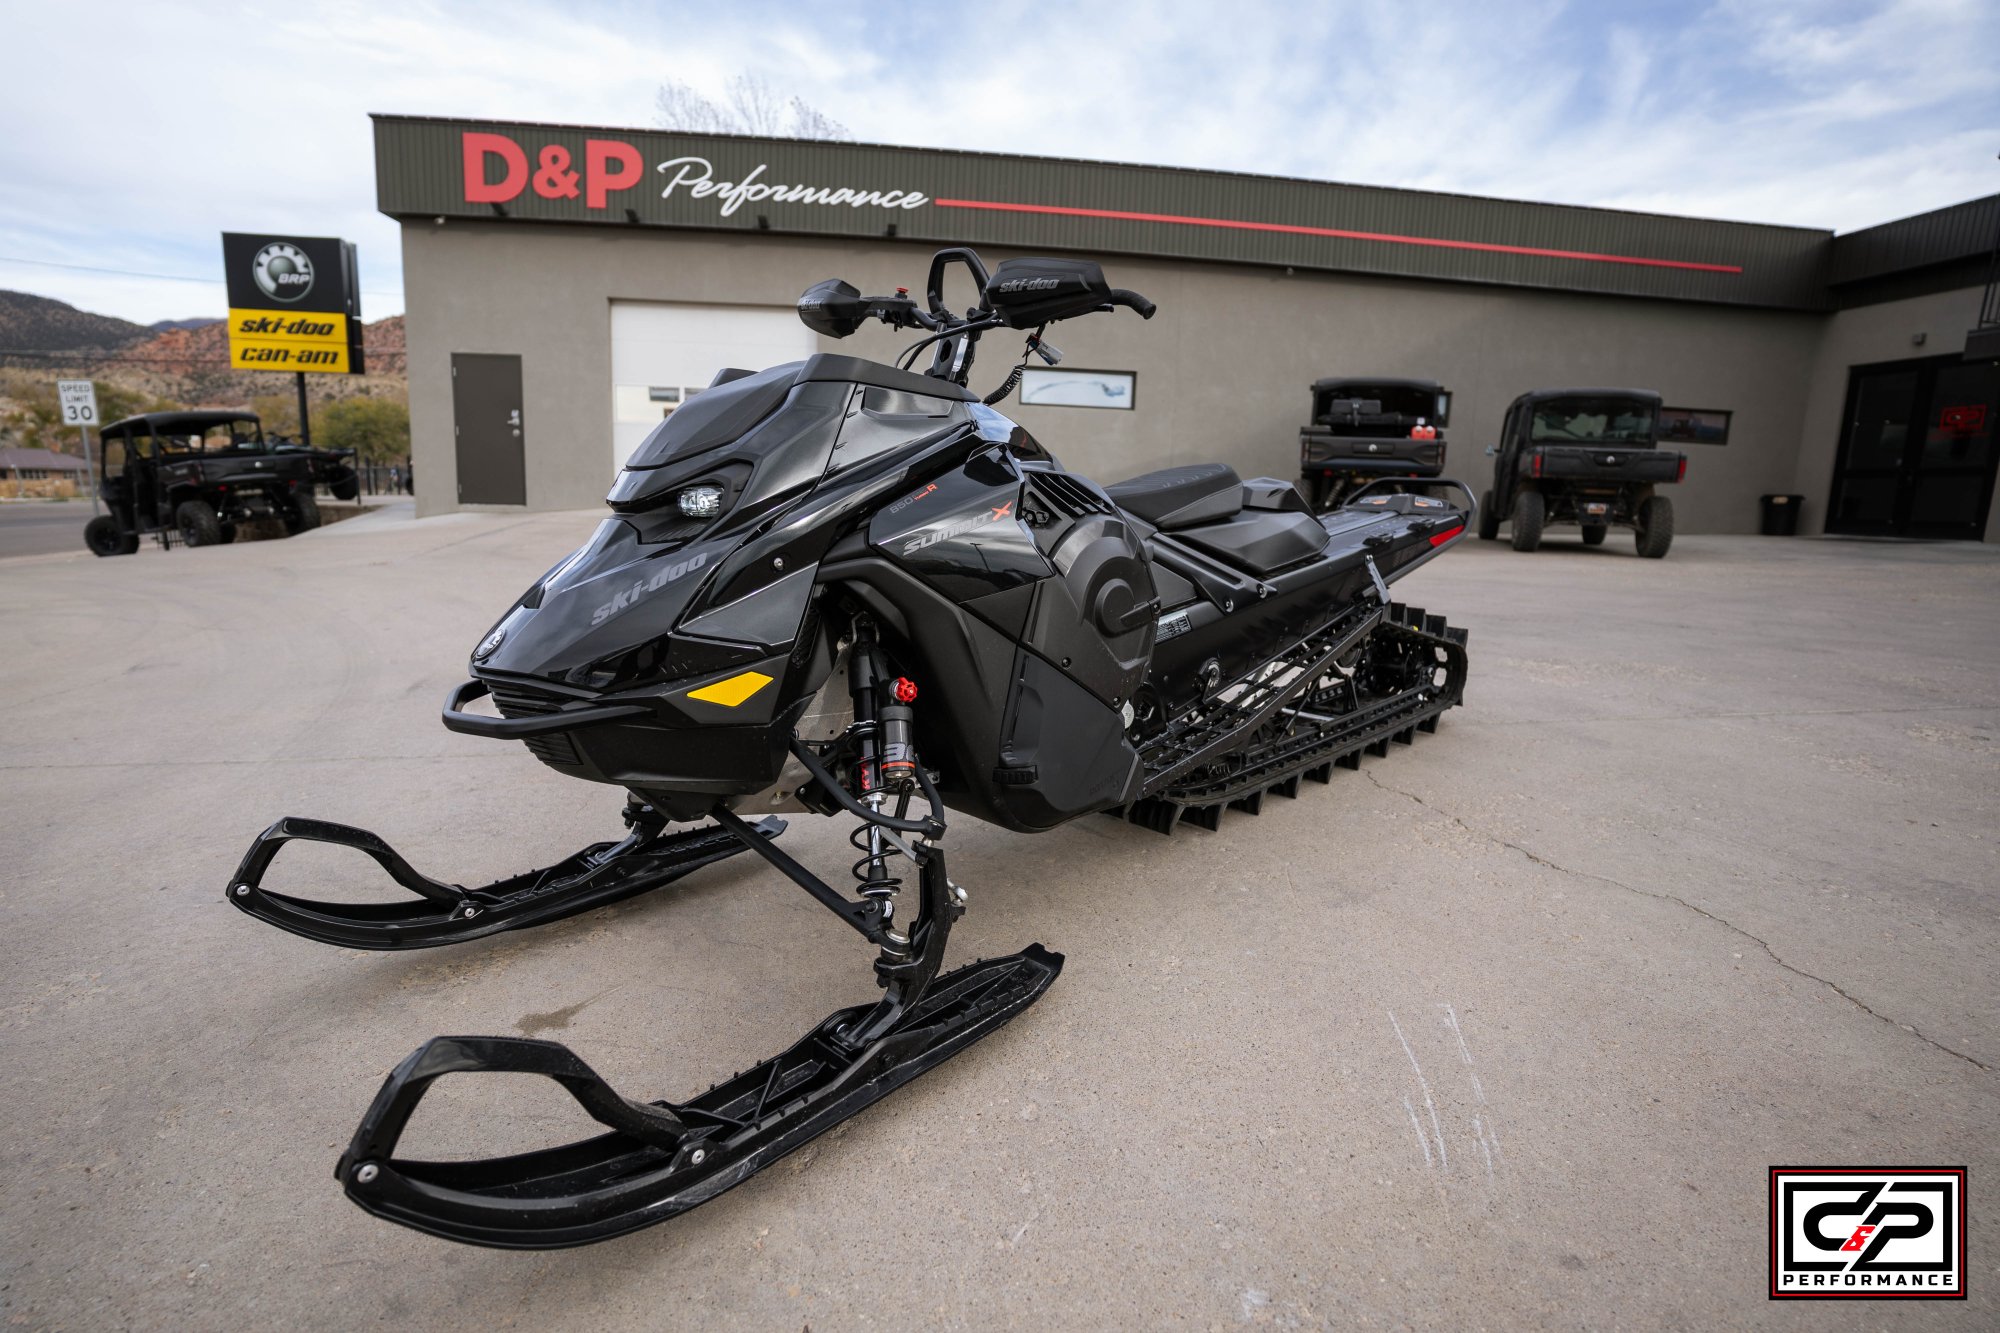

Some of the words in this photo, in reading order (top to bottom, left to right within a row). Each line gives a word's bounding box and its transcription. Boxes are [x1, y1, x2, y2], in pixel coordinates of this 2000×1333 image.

[462, 132, 644, 209] D&P
[656, 156, 929, 217] Performance
[278, 272, 311, 284] BRP
[999, 277, 1060, 293] ski-doo
[239, 317, 335, 336] ski-doo
[240, 347, 339, 365] can-am
[61, 384, 90, 392] SPEED
[65, 394, 88, 403] LIMIT
[67, 405, 92, 420] 30
[890, 496, 914, 514] 850
[903, 511, 992, 556] SUMMIT
[991, 500, 1012, 522] X
[591, 552, 708, 626] ski-doo
